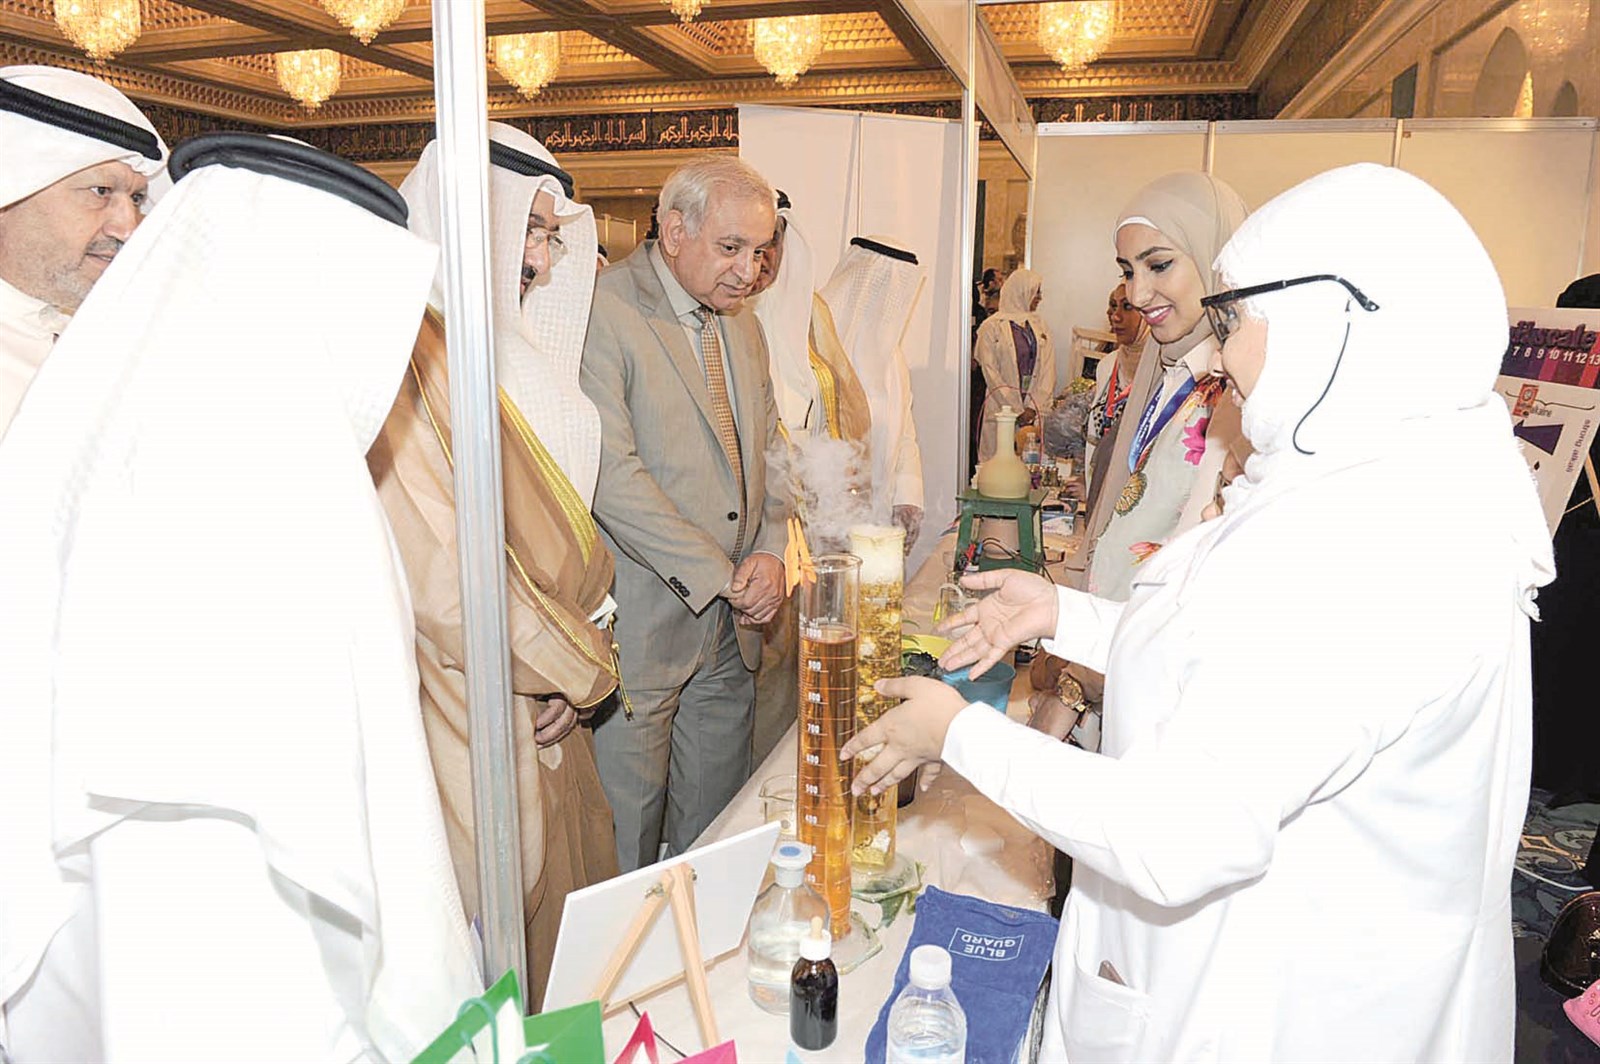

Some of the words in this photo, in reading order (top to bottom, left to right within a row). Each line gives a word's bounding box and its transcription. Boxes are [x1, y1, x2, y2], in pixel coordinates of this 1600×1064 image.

[1512, 346, 1521, 356] 7
[1523, 346, 1533, 358] 8
[1536, 348, 1545, 359] 9
[1548, 348, 1561, 360] 10
[1562, 350, 1574, 362] 11
[1575, 352, 1588, 364] 12
[1589, 354, 1600, 366] 13
[961, 933, 1016, 948] GUARD
[964, 943, 1006, 957] BLUE
